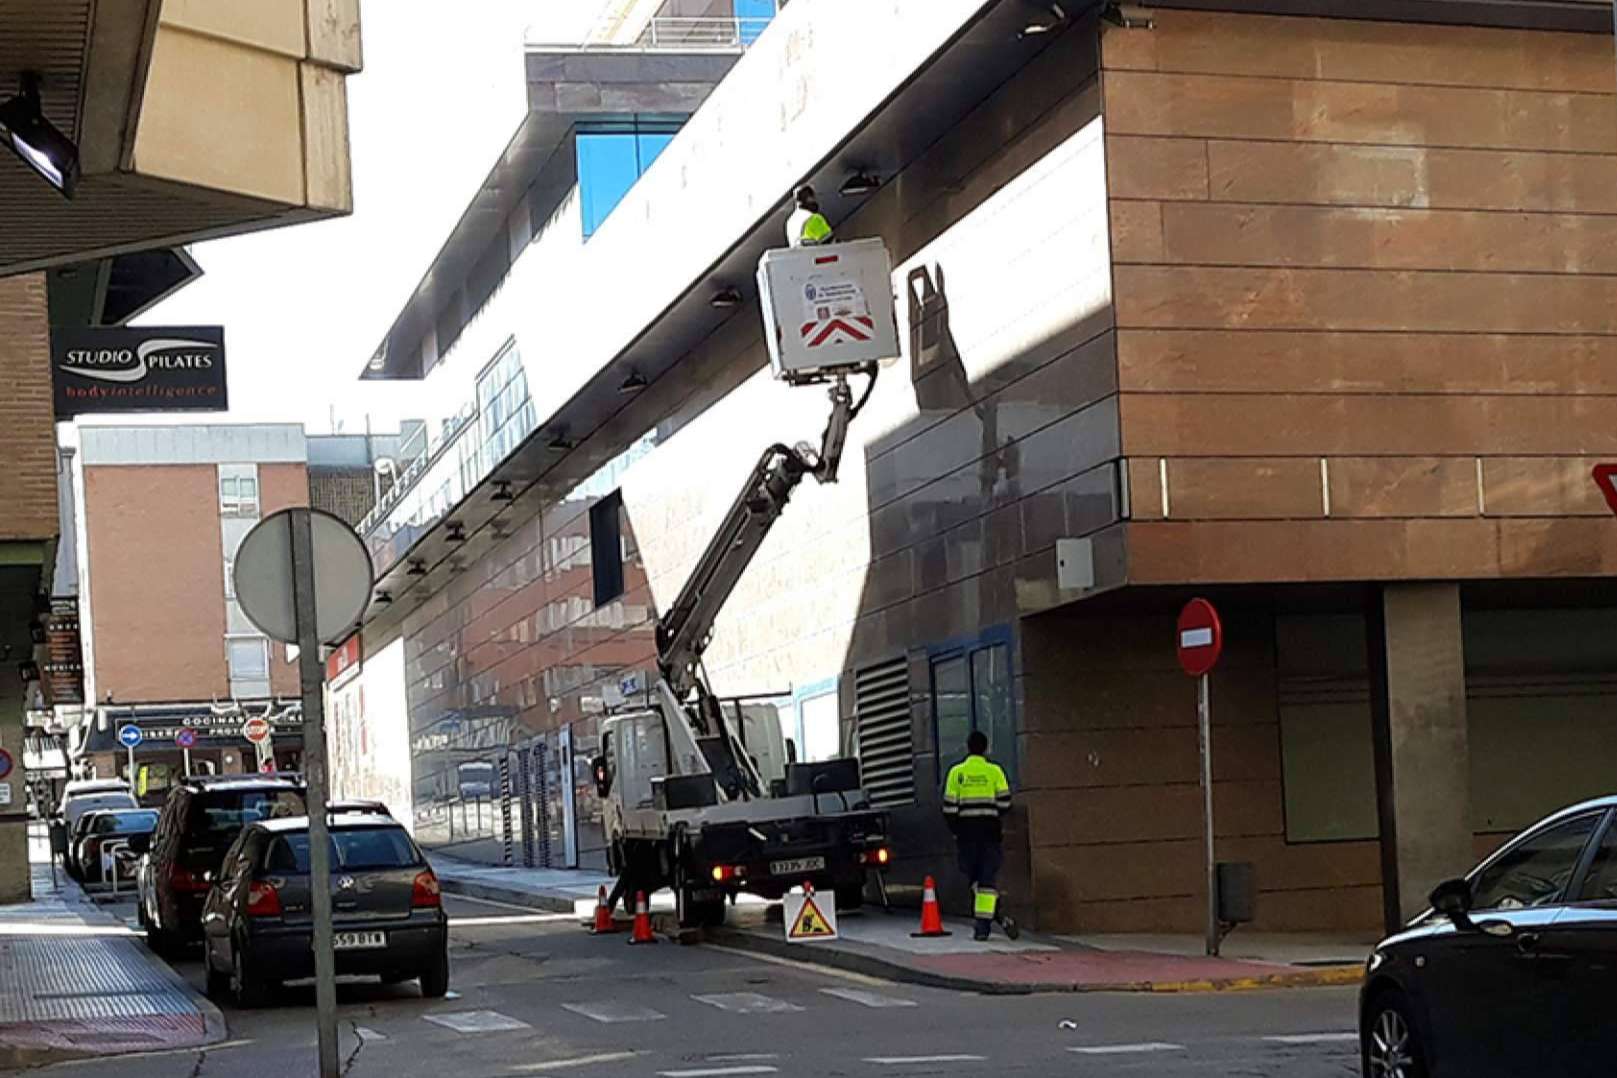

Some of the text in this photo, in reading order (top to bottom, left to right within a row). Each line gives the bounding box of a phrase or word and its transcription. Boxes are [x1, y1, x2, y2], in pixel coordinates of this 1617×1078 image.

[66, 350, 212, 369] STUDIO PILATES
[65, 386, 217, 399] bodyintelligence
